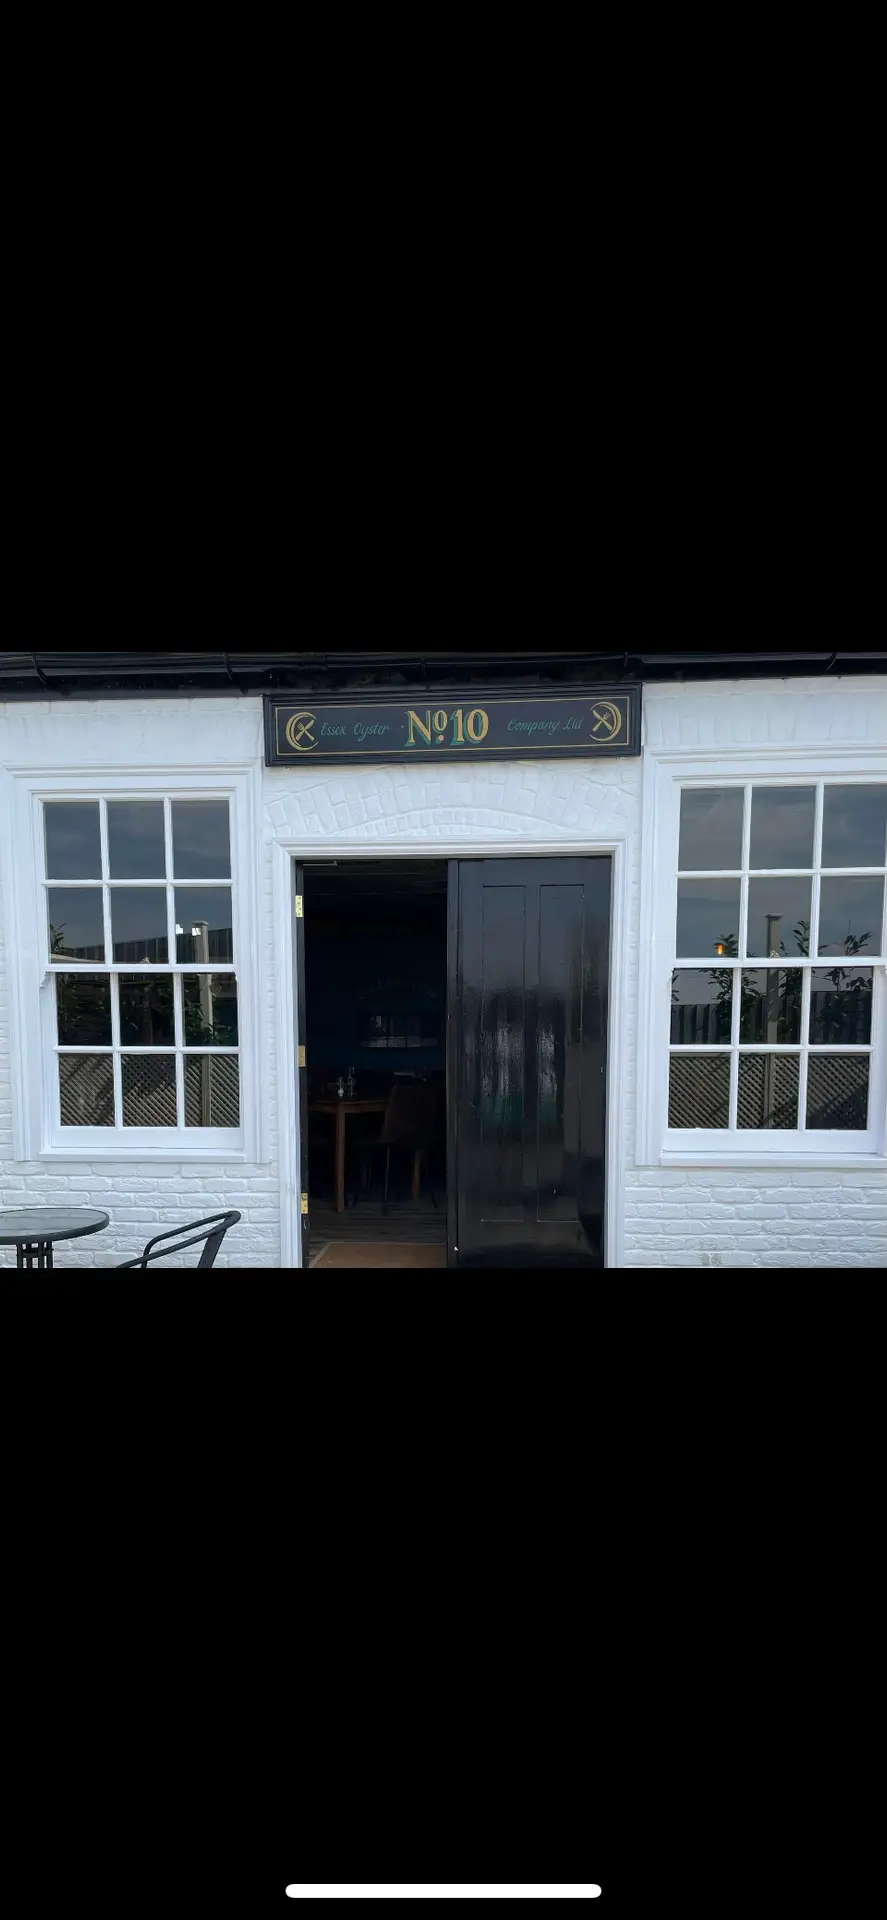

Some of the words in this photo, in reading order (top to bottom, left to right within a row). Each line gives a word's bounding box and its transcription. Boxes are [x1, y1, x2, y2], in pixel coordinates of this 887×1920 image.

[320, 722, 346, 736] Essex
[353, 722, 389, 742] Oyster
[507, 717, 560, 736] Company
[563, 716, 584, 730] Ltd
